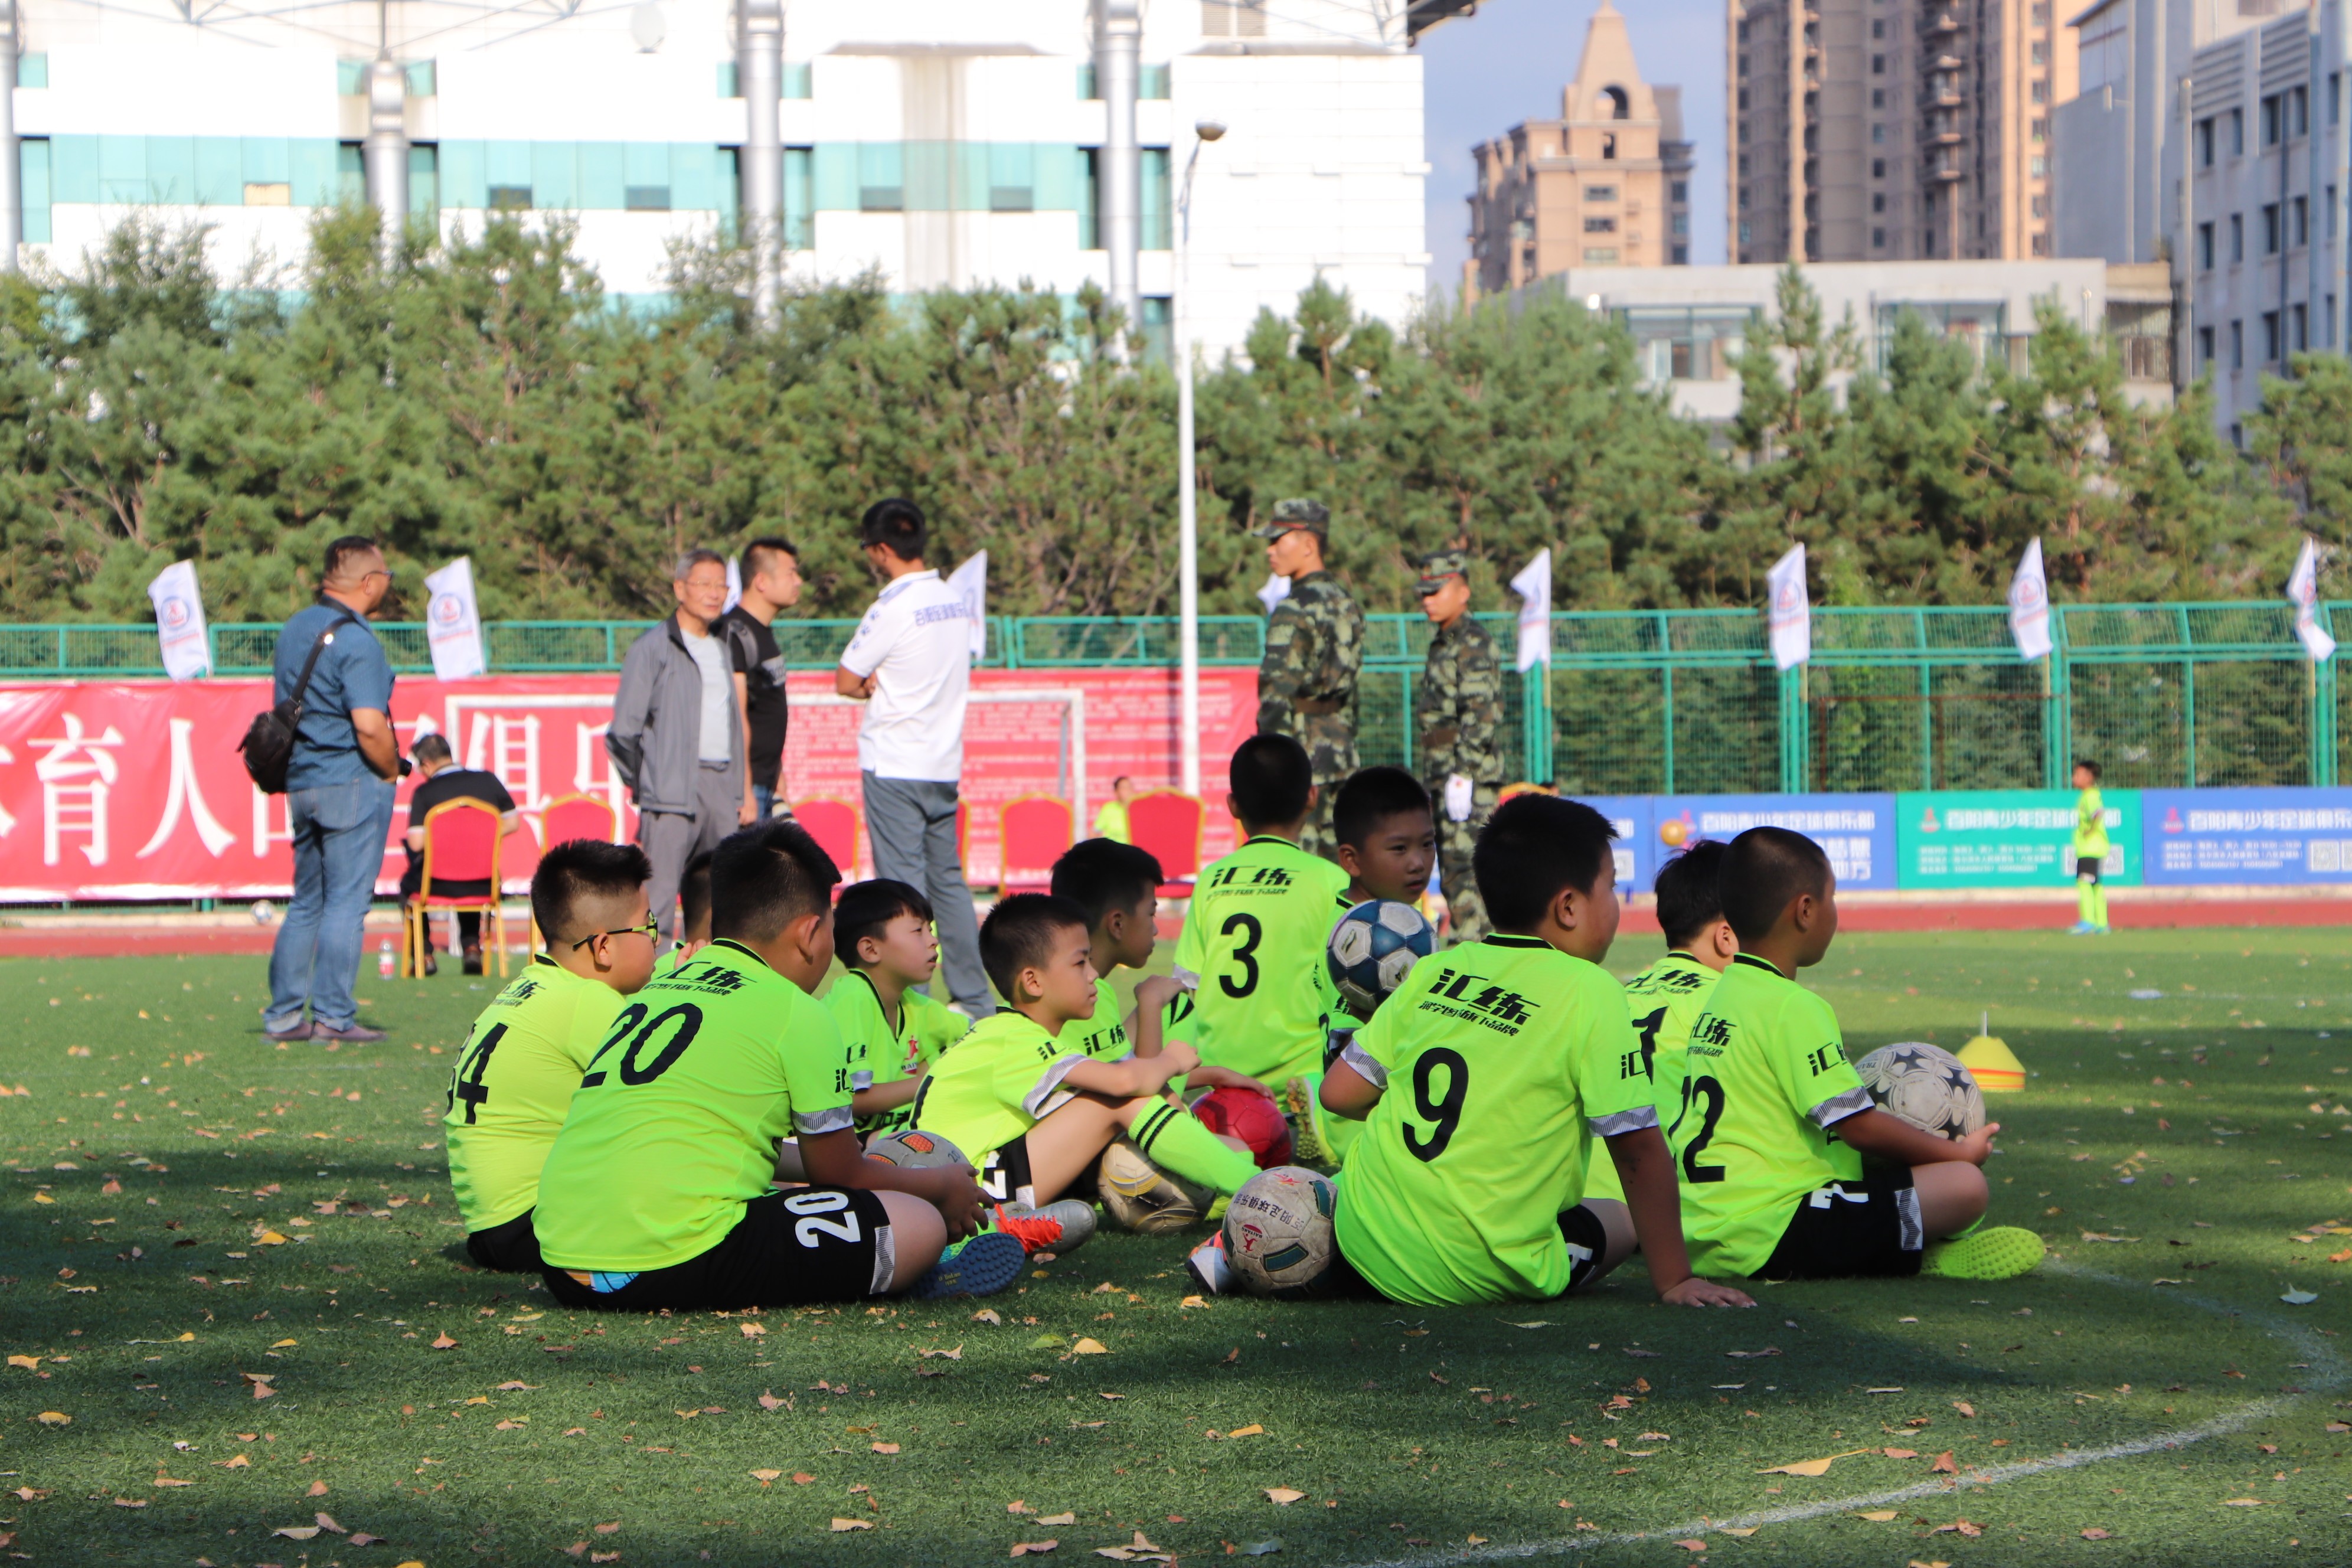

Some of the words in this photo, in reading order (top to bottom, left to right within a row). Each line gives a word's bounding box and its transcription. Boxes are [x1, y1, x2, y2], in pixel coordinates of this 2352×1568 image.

[1219, 913, 1262, 998] 3
[1427, 968, 1541, 1025] 汇练
[446, 1023, 509, 1125] 4
[581, 1002, 703, 1089] 20
[1621, 1050, 1647, 1080] 汇
[1402, 1047, 1469, 1164] 9
[784, 1191, 861, 1249] 20
[1241, 1226, 1263, 1239] BAIYANG
